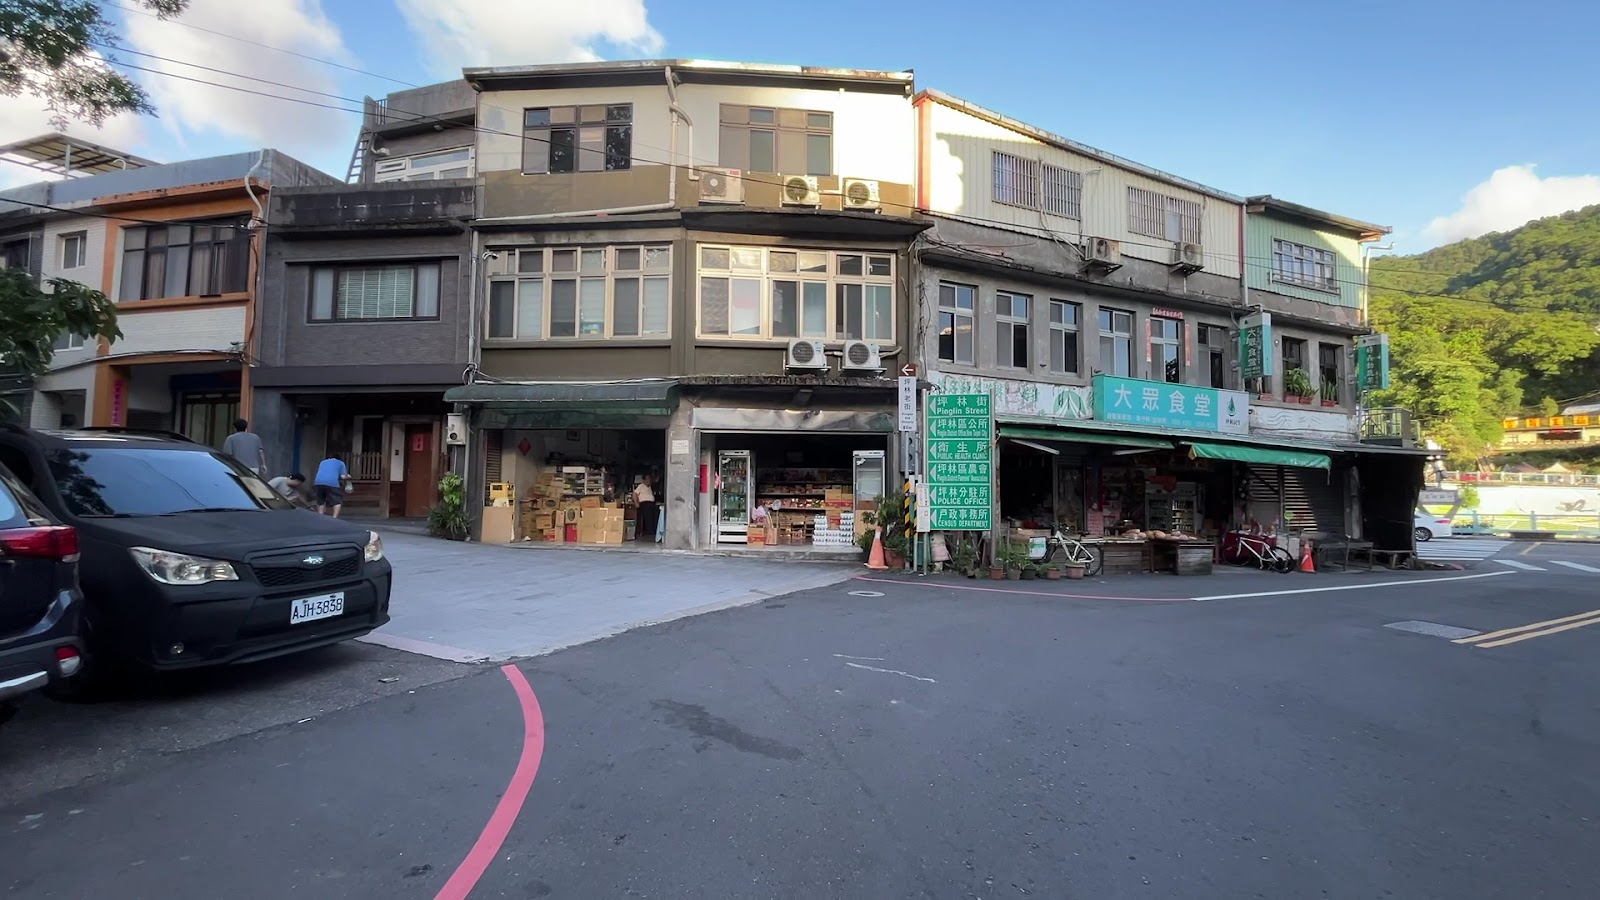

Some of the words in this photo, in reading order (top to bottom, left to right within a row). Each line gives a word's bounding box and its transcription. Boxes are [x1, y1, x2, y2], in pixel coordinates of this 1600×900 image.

[937, 396, 987, 407] 坪林街
[1114, 383, 1211, 417] 大眾食堂
[937, 407, 962, 416] Pinglin
[965, 406, 987, 415] Street
[937, 418, 987, 429] 坪林區公所
[937, 441, 987, 453] 衛生所
[937, 452, 953, 460] PUBLIC
[954, 452, 971, 460] HEALTH
[972, 452, 987, 460] CLINIC
[937, 463, 987, 474] 坪林區農會
[938, 486, 988, 498] 坪林分駐所
[958, 520, 988, 528] DEPARTMENT
[292, 598, 343, 620] AJH-3838
